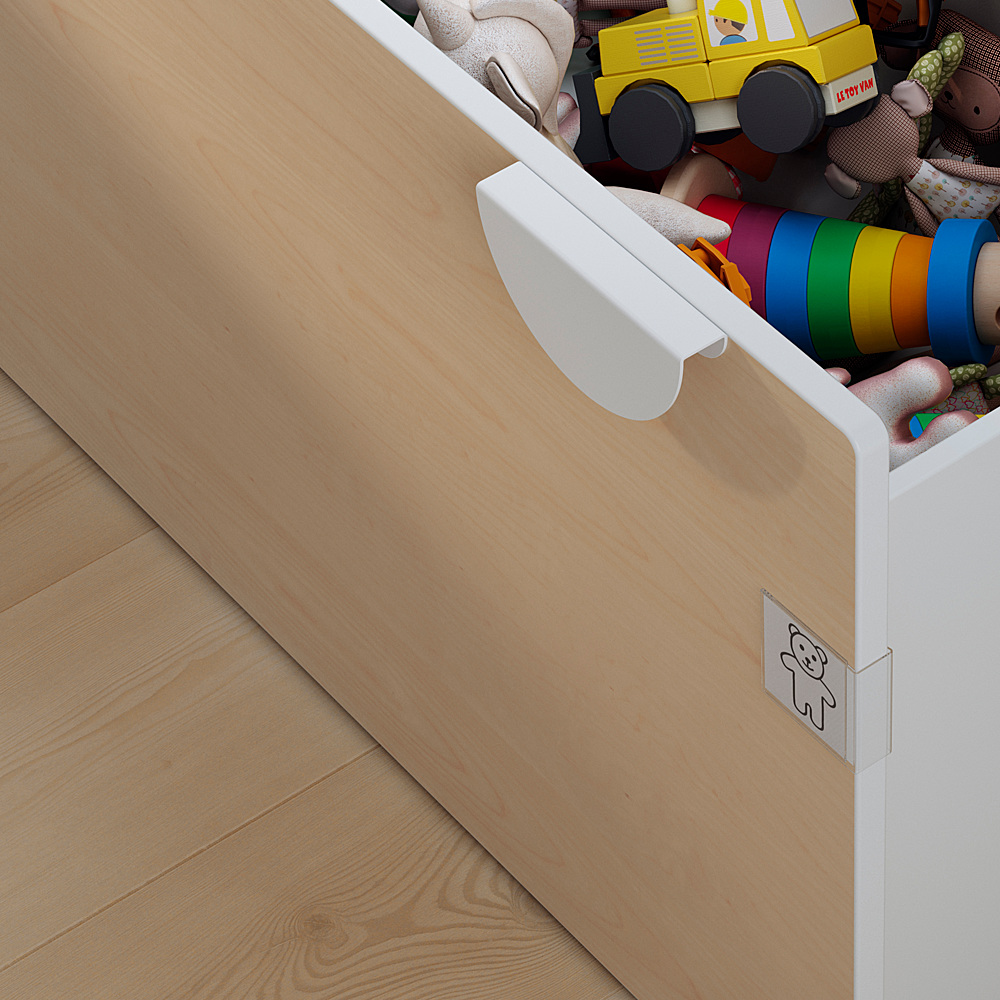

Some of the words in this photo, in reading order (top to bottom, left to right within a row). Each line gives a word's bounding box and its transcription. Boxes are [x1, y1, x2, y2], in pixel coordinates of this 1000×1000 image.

[836, 90, 845, 103] LE
[844, 84, 859, 99] TOY
[859, 77, 874, 93] VAN
